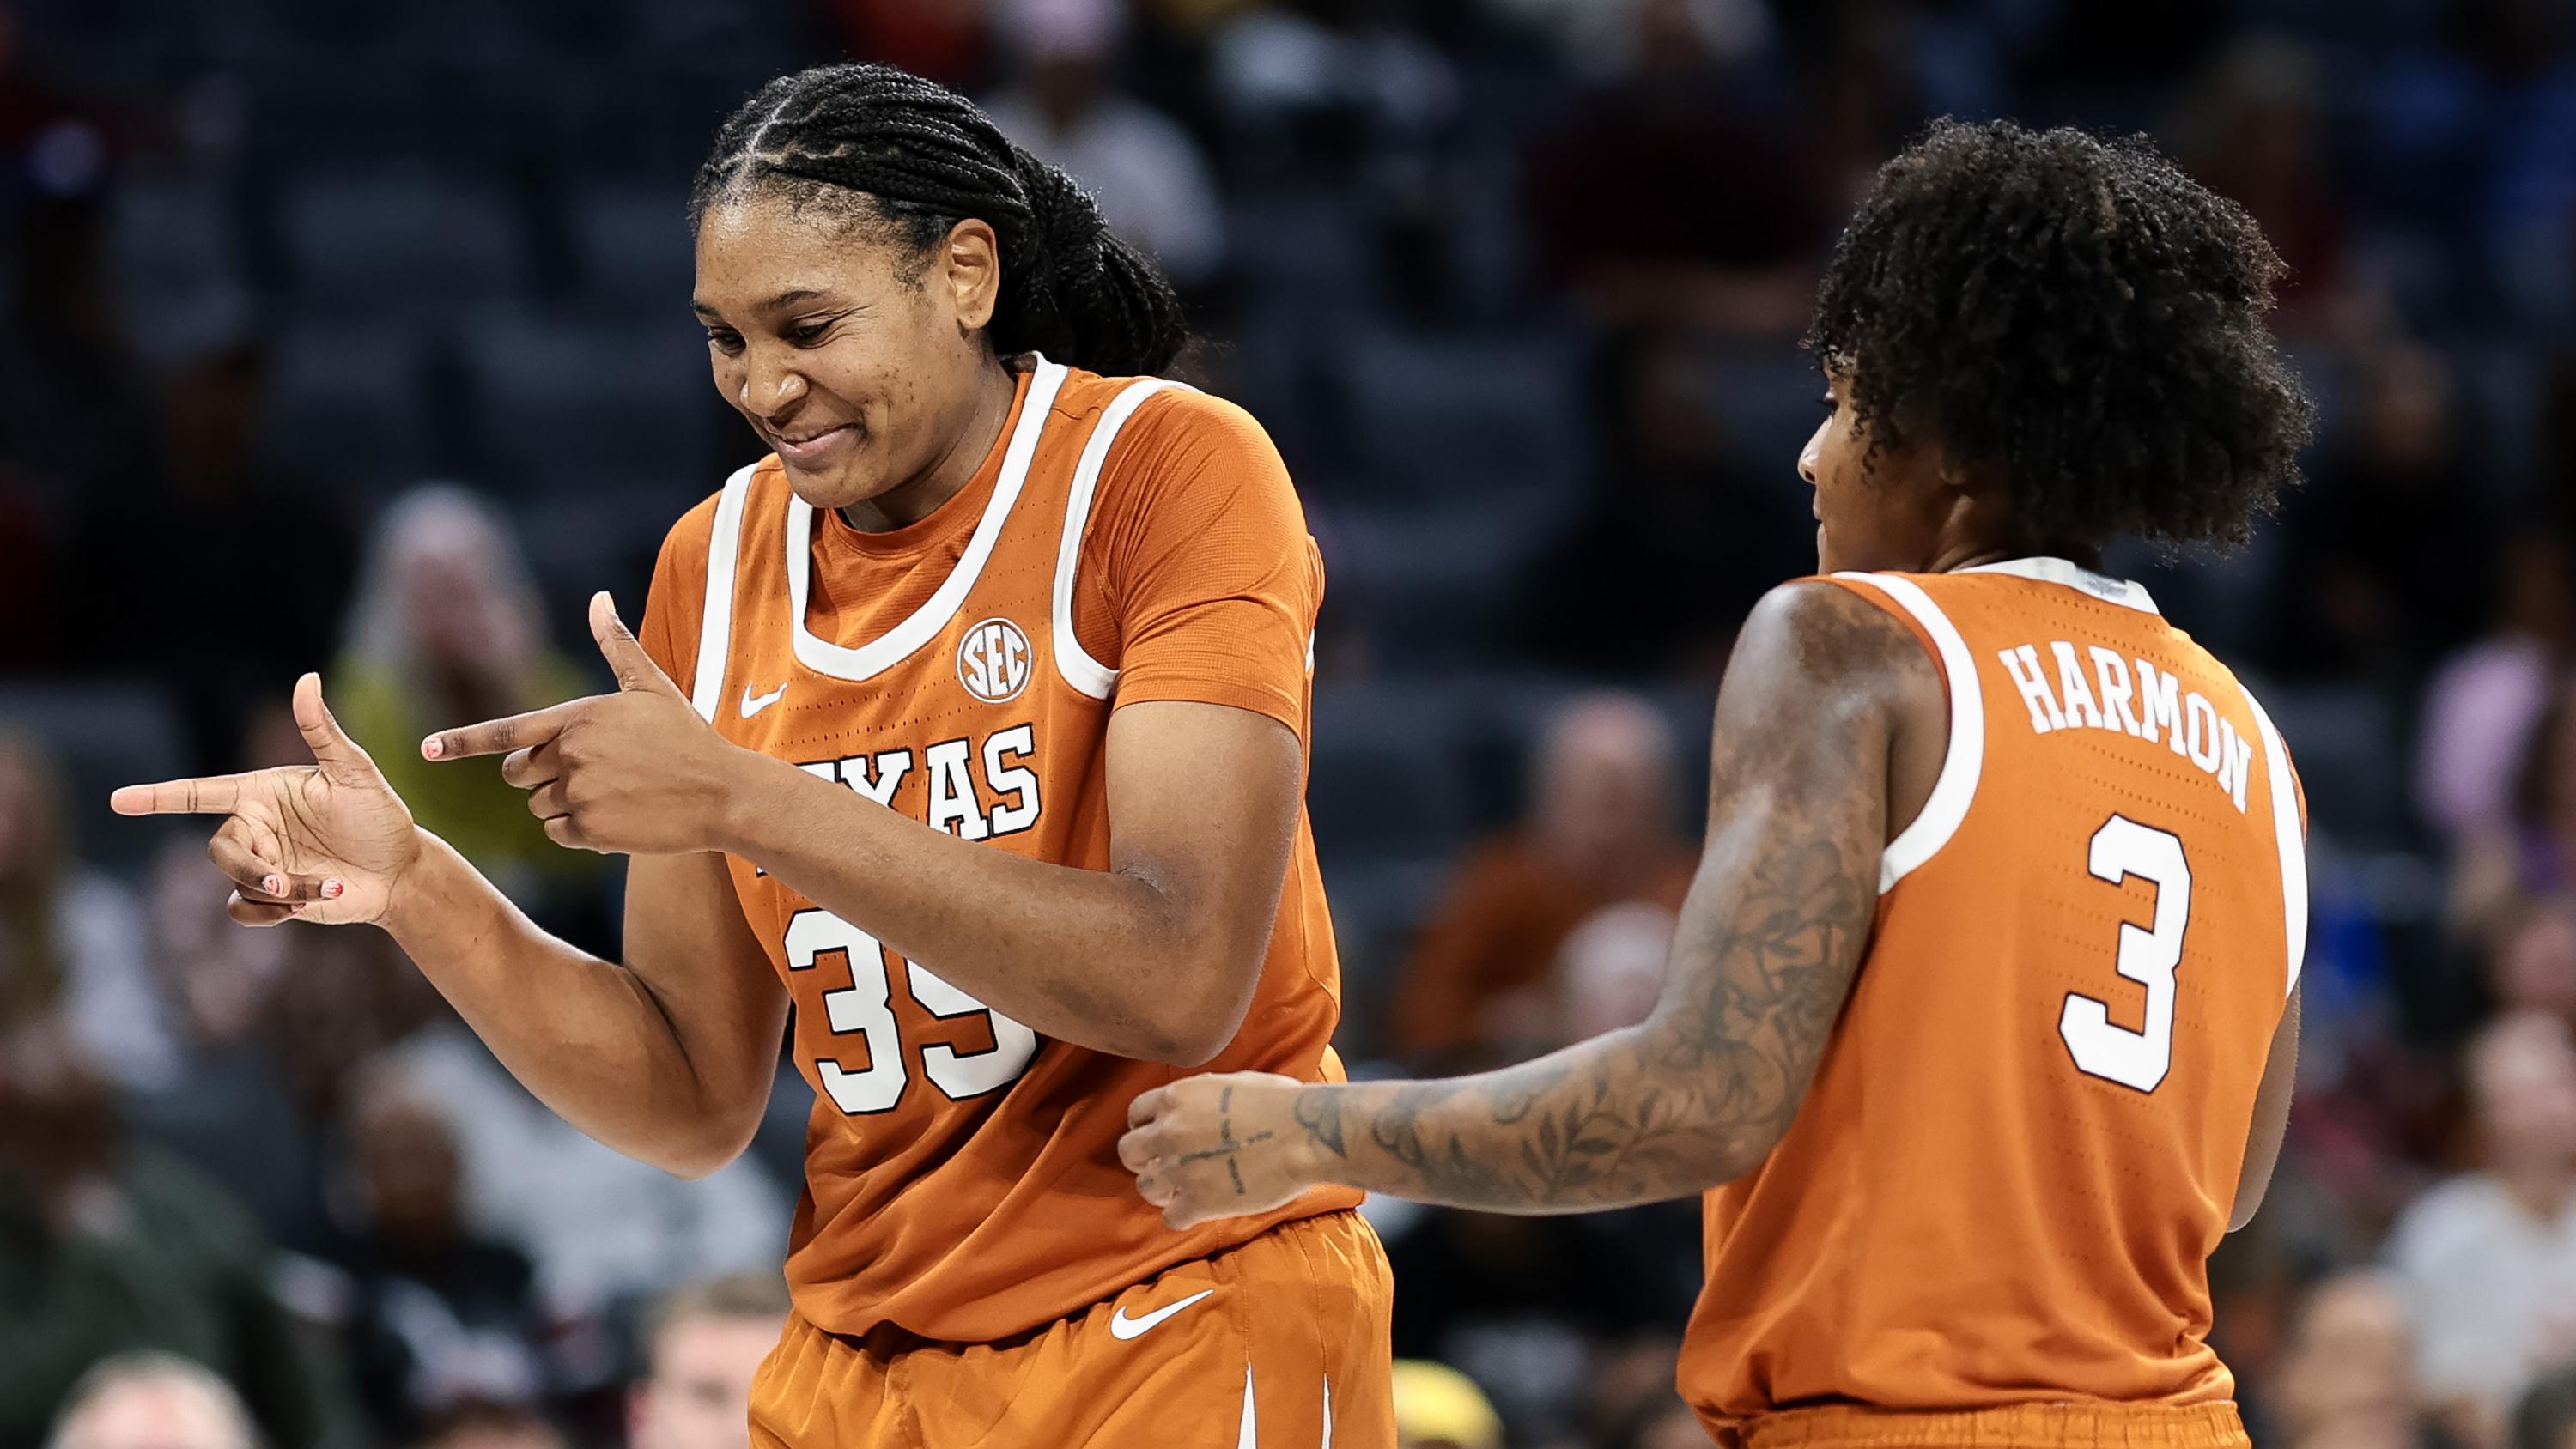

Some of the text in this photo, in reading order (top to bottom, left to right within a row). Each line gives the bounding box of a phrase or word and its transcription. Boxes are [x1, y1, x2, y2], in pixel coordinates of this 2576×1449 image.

[963, 624, 1026, 697] SEC
[1997, 640, 2251, 815] HARMON
[2058, 812, 2192, 1095] 3
